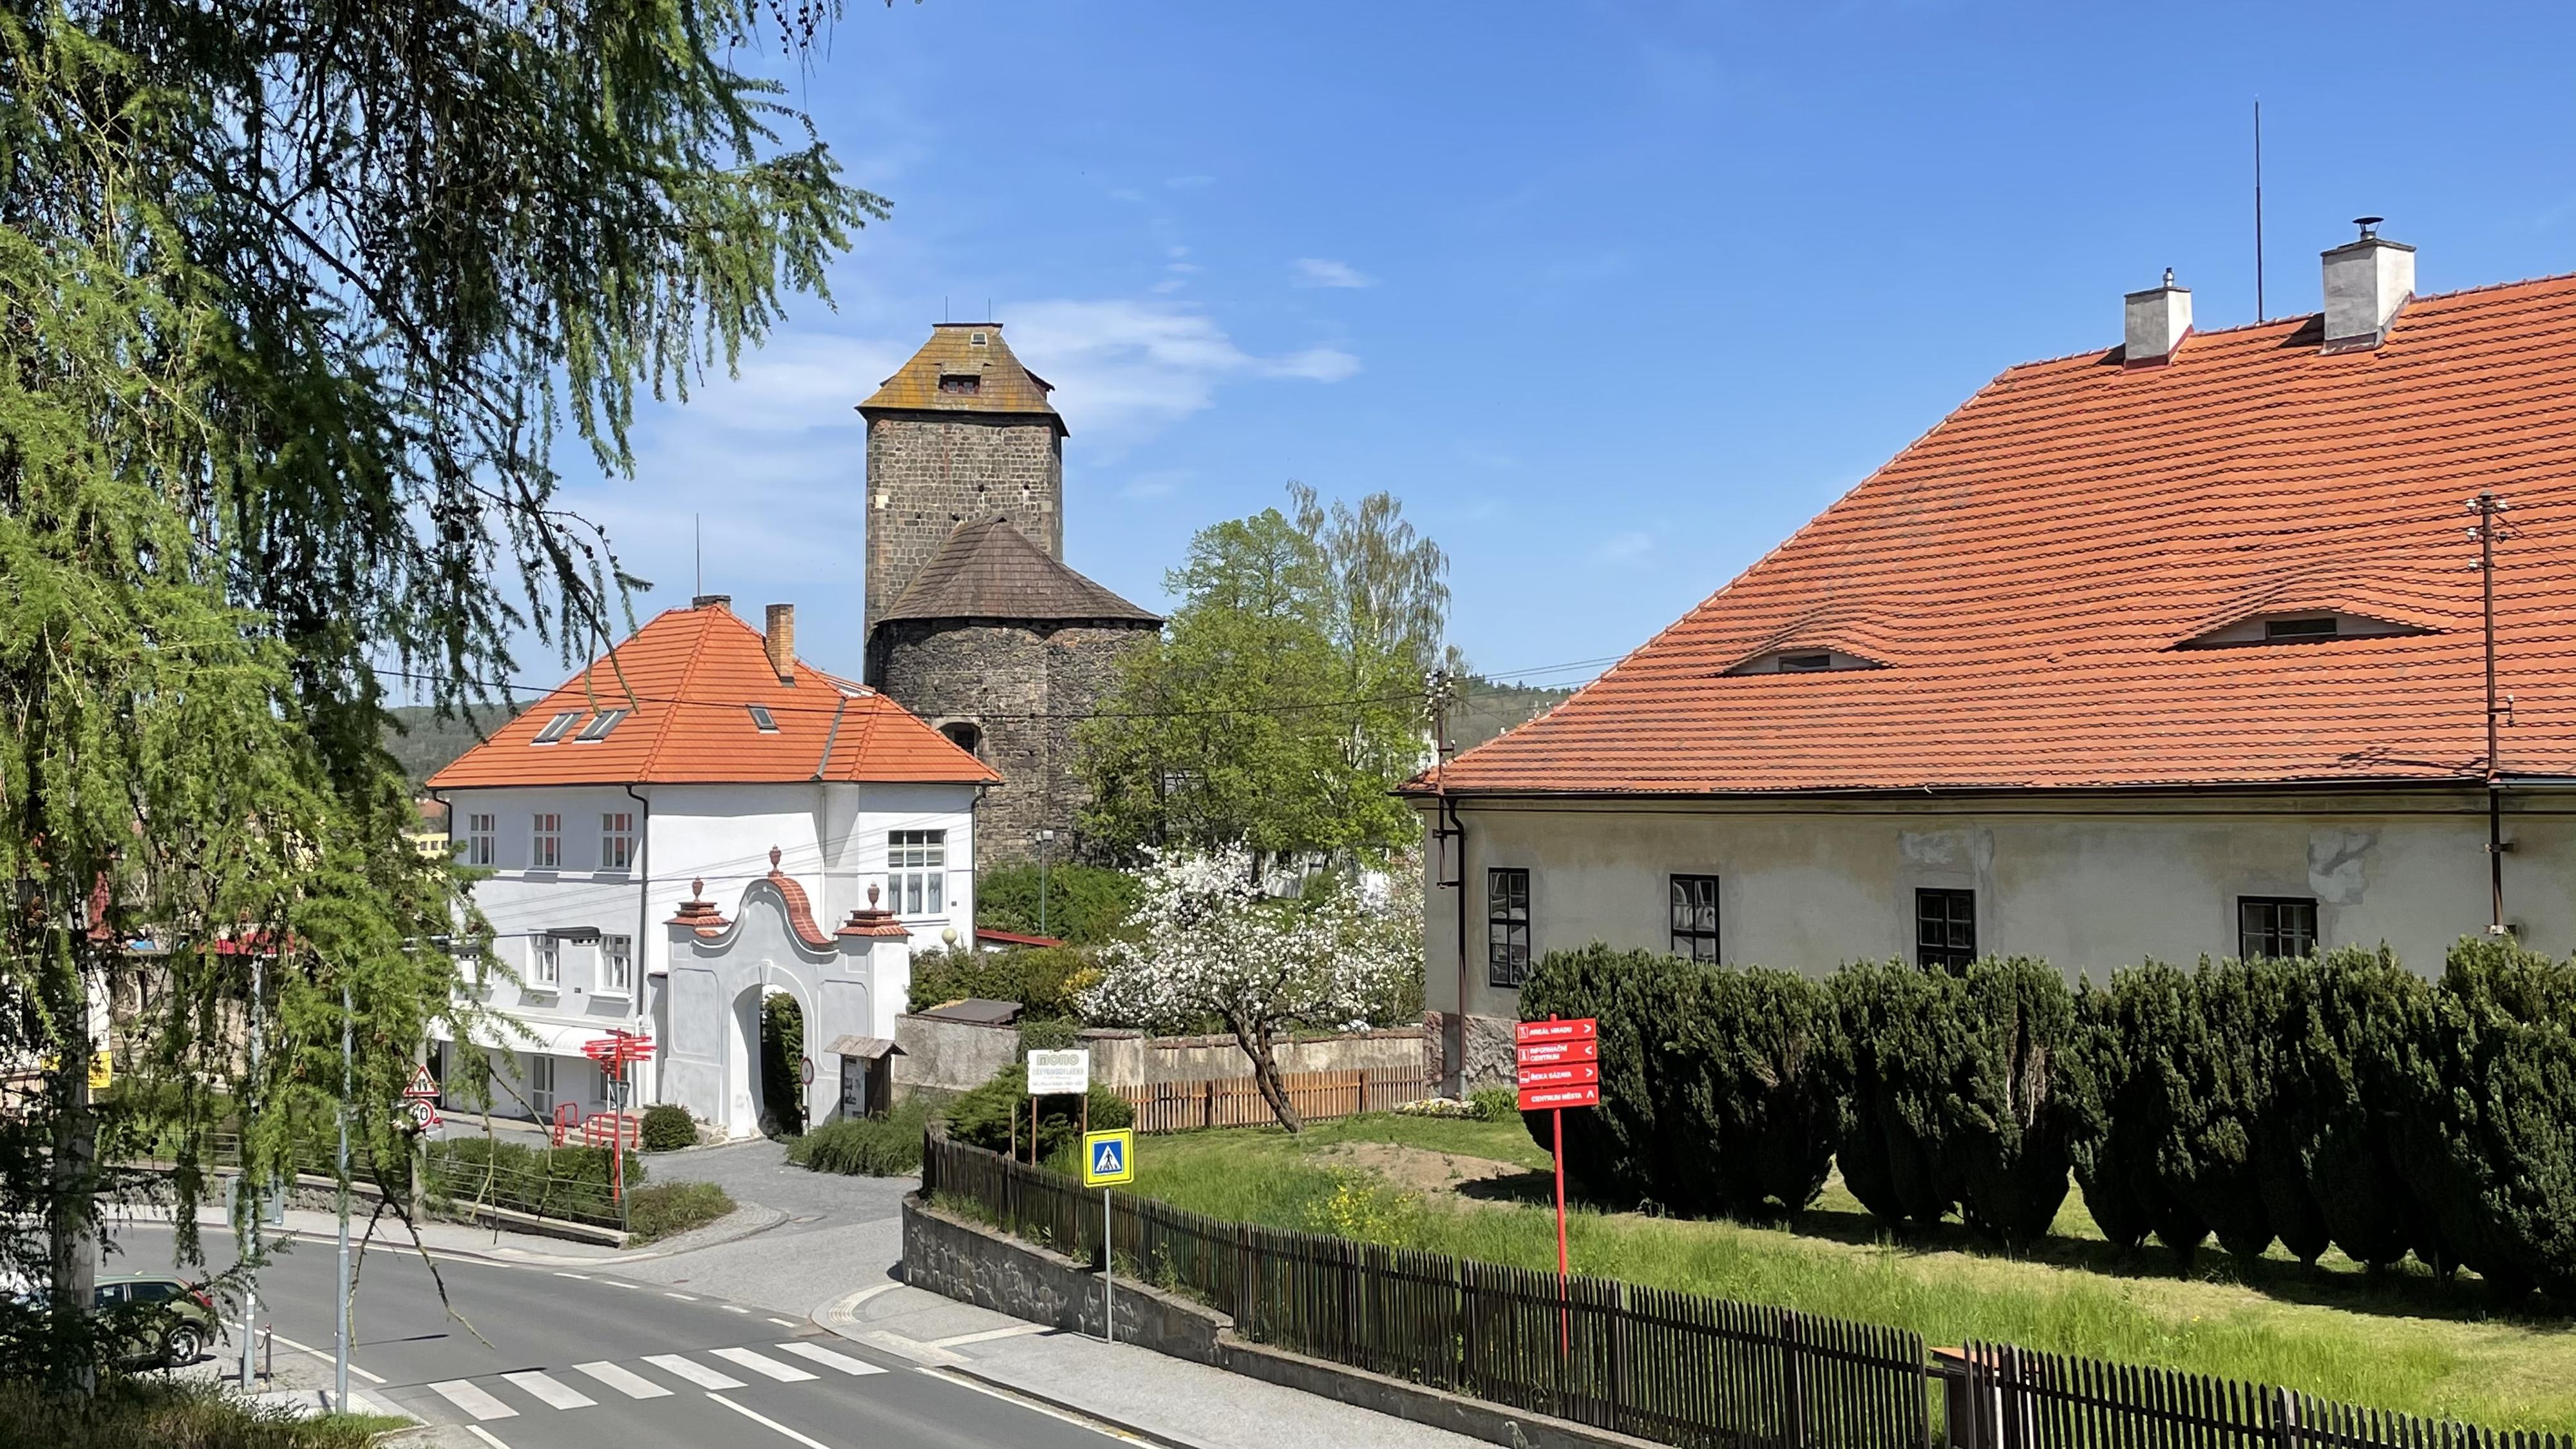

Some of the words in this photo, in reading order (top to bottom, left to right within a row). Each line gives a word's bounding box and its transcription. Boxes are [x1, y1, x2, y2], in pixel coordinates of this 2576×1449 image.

[1530, 1054, 1560, 1062] CENTRUM
[1548, 1071, 1572, 1079] SÁZAVA
[1531, 1094, 1561, 1103] CENTRUM
[1562, 1092, 1582, 1100] MĚSTA
